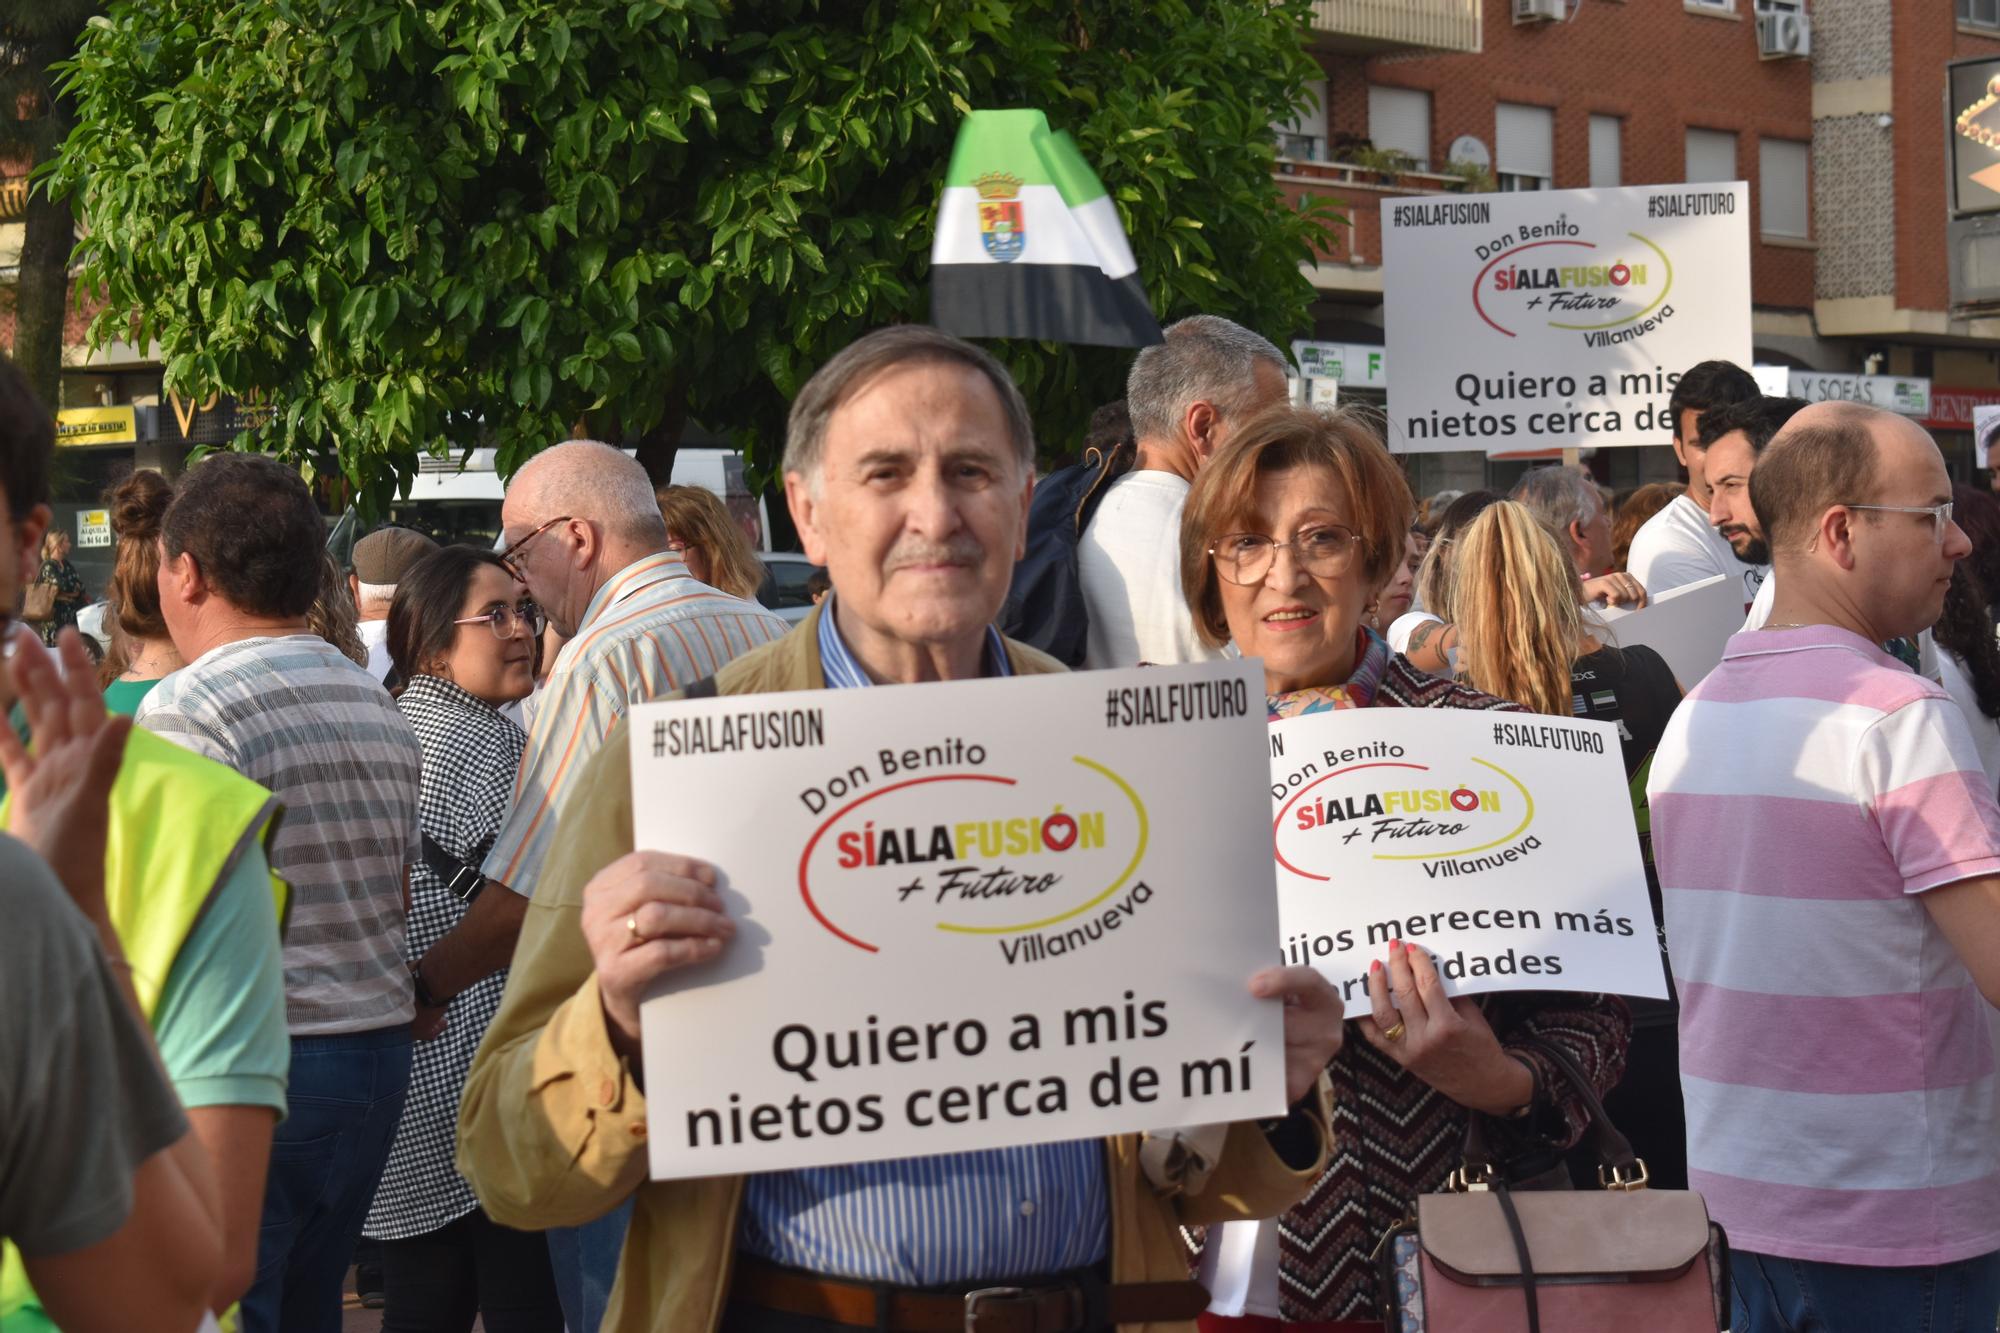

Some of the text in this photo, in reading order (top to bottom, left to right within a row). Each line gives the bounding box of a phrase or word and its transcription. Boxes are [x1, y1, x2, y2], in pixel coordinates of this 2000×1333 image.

[1393, 202, 1490, 228] #SIALAFUSION
[1647, 192, 1735, 218] #SIALFUTURO
[1474, 217, 1580, 263] Don Benito
[1548, 291, 1622, 313] Futuro
[1583, 303, 1675, 349] Villanueva
[1455, 366, 1680, 407] Quiero a mis
[1407, 402, 1674, 439] nietos cerca de
[1106, 678, 1248, 727] #SIALFUTURO
[652, 708, 825, 757] #SIALAFUSION
[1493, 723, 1605, 755] #SIALFUTURO
[800, 738, 987, 815] Don Benito
[1271, 762, 1318, 801] Don
[1324, 740, 1405, 767] Benito
[1371, 817, 1470, 844] Futuro
[1422, 834, 1543, 880] Villanueva
[936, 867, 1062, 903] Futuro
[999, 881, 1154, 966] Villanueva
[1367, 909, 1541, 945] merecen
[1554, 908, 1635, 938] más
[772, 990, 1168, 1082] Quiero a mis
[686, 1040, 1256, 1148] nietos cerca de mí
